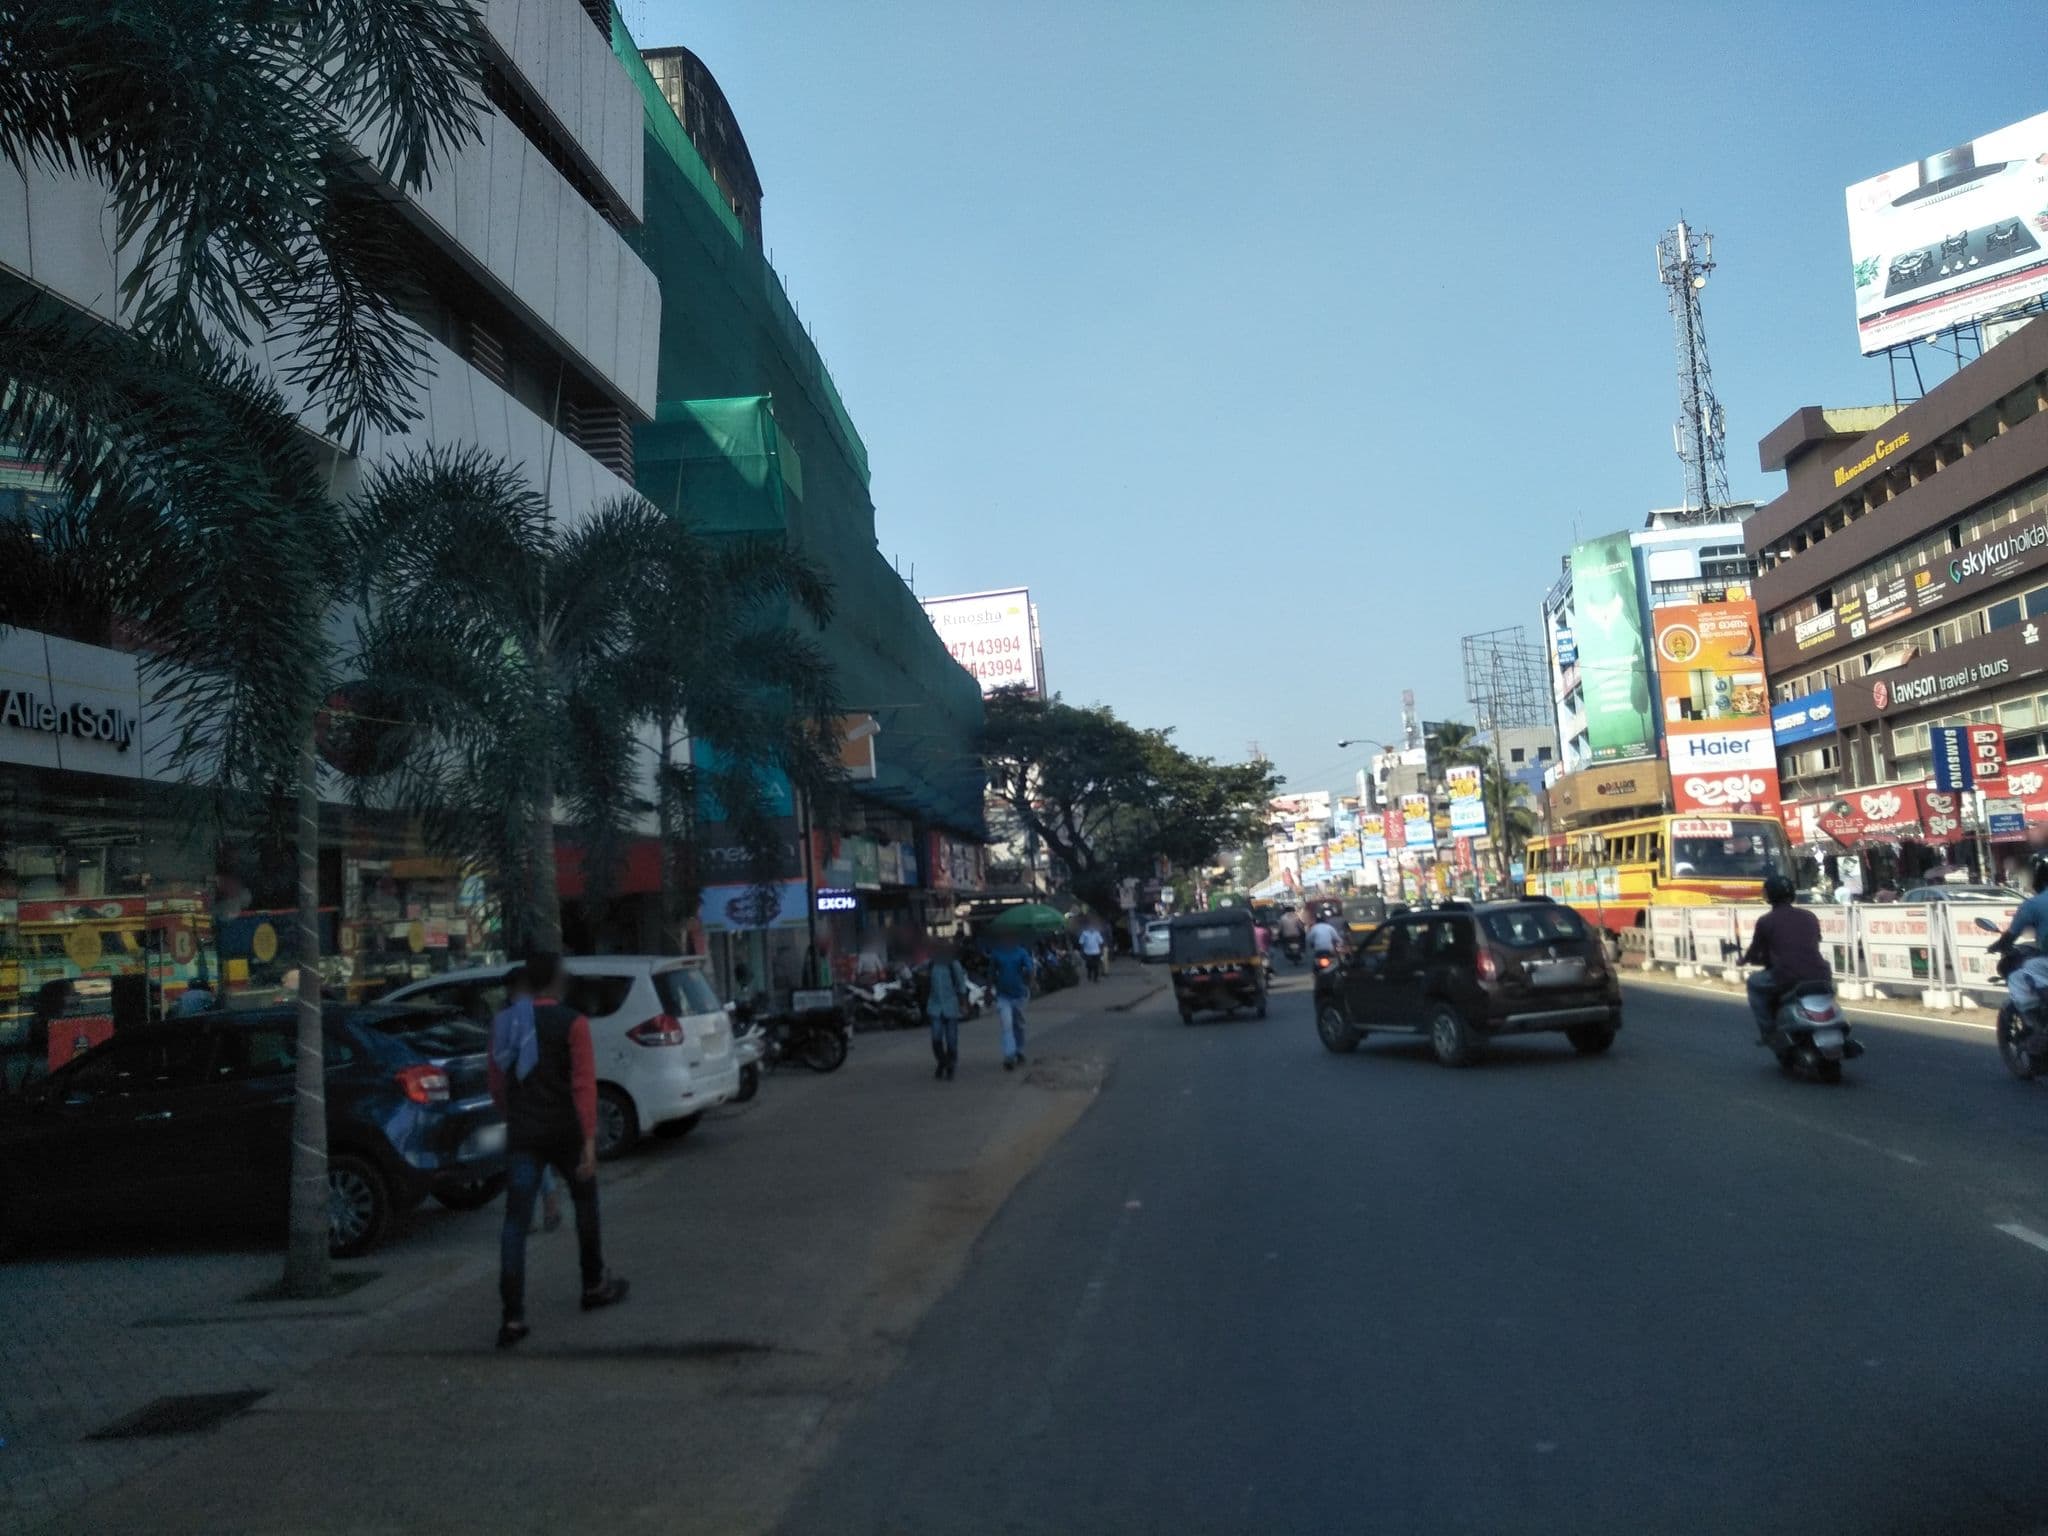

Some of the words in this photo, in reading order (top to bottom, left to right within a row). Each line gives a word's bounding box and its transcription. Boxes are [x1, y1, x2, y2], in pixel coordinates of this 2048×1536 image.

[1961, 541, 2009, 576] skykru
[1891, 675, 1937, 705] lawson
[1938, 668, 1969, 692] travel
[1970, 669, 1978, 682] &
[1978, 658, 2009, 680] tours
[1, 689, 74, 735] Allen
[77, 703, 137, 752] Solly
[1689, 737, 1751, 757] Haier
[1943, 729, 1964, 789] SAMSUNG
